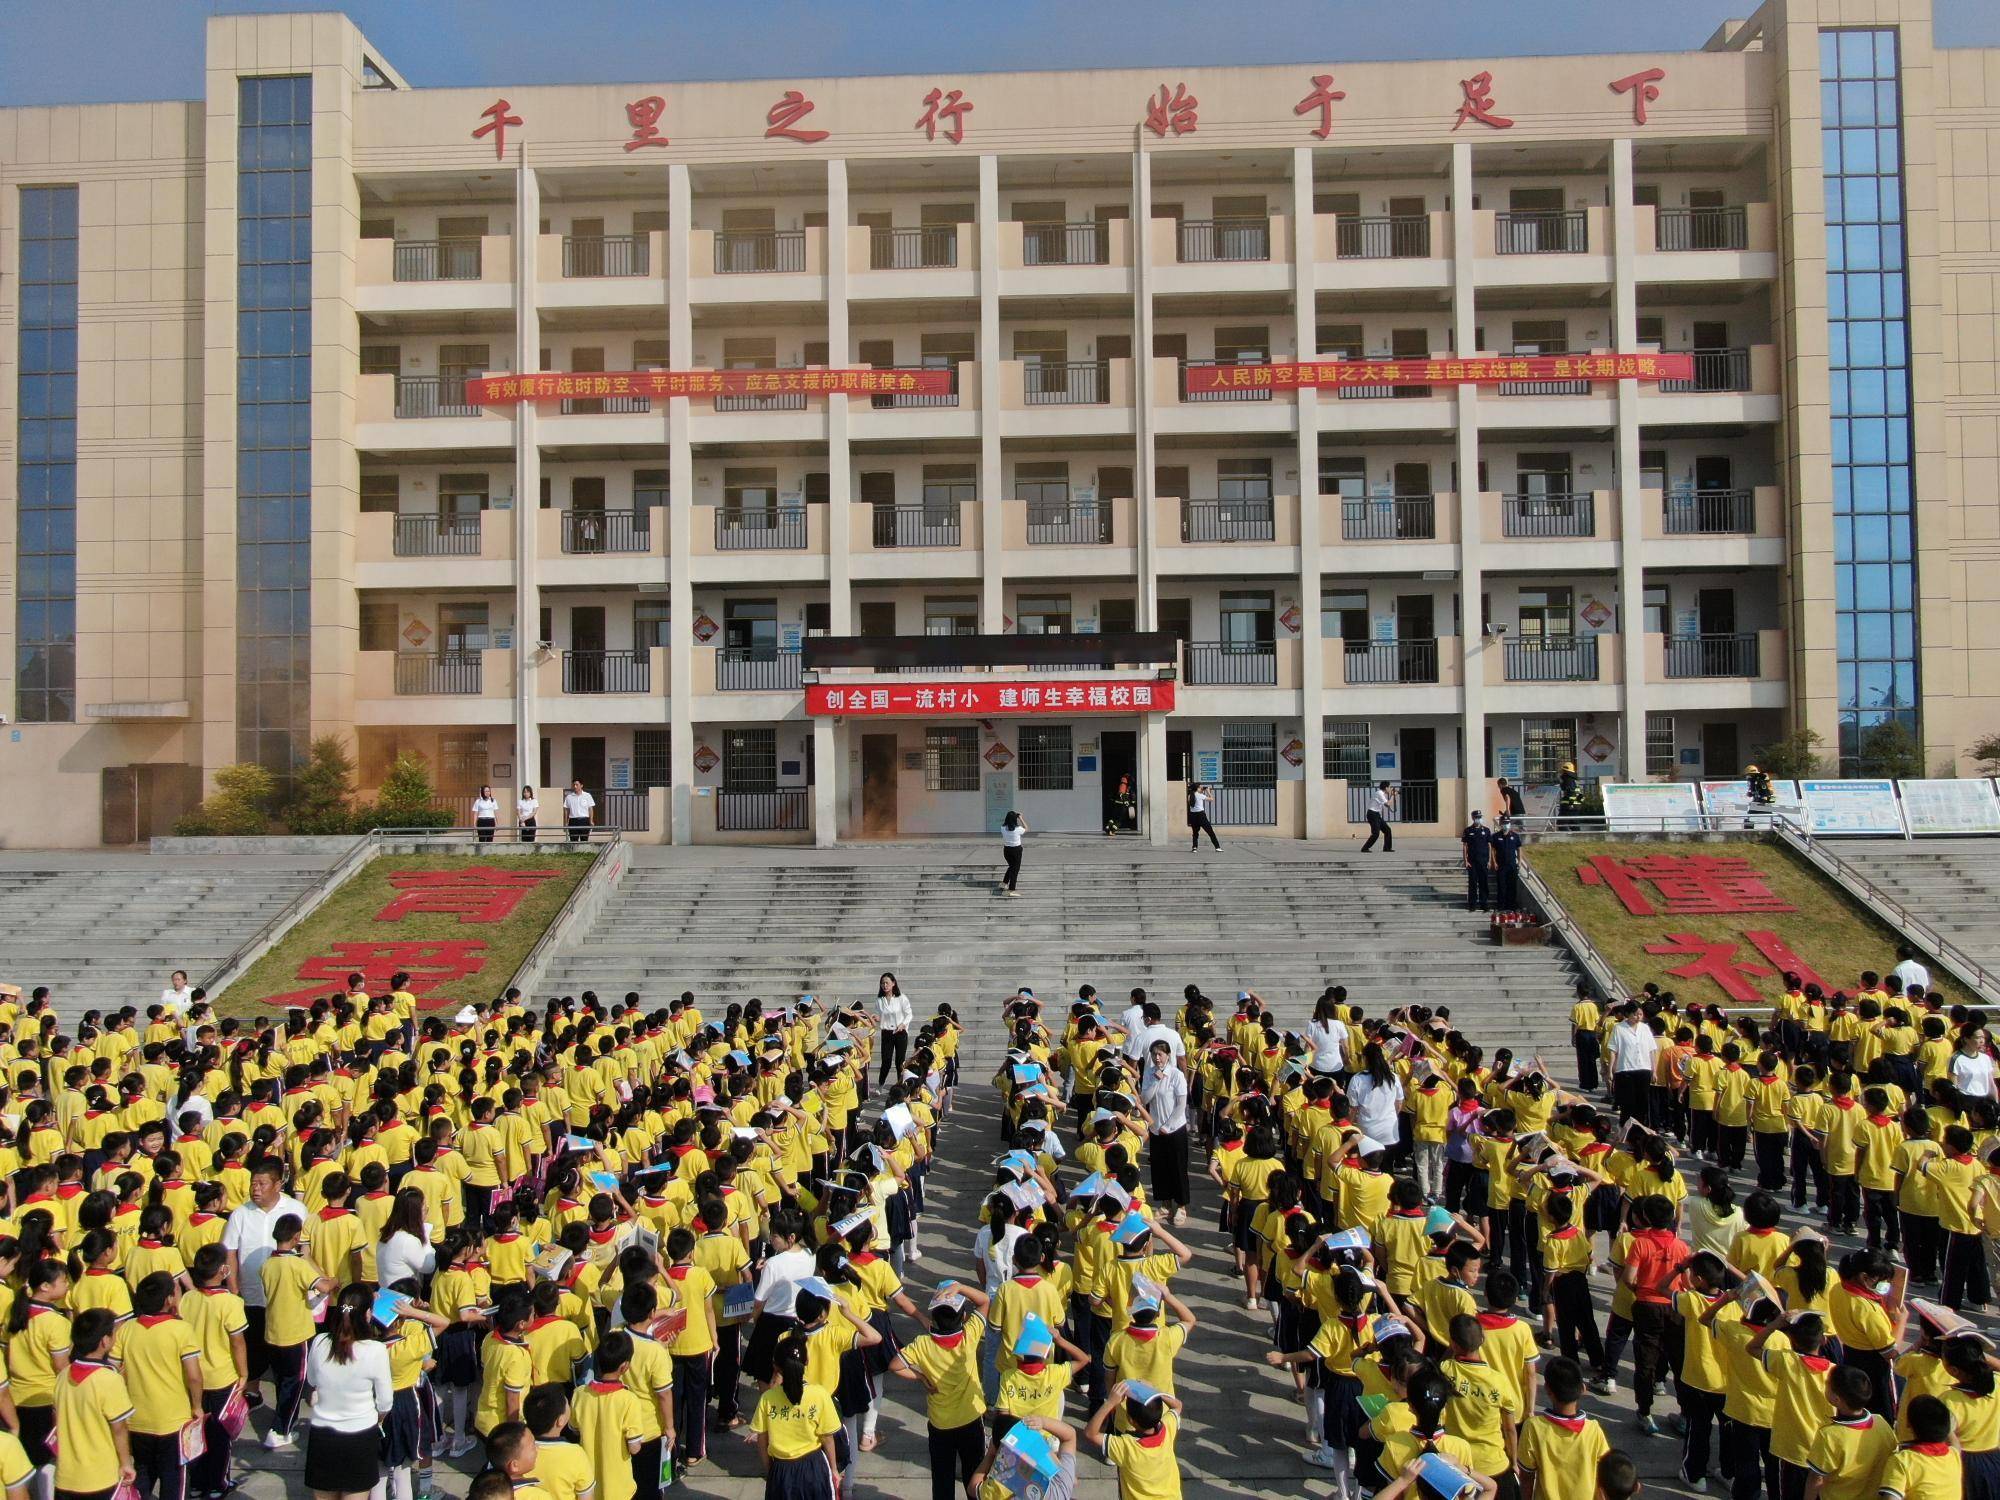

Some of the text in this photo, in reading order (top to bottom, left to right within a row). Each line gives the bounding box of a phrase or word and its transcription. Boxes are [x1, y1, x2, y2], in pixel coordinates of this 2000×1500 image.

[471, 67, 1666, 161] 千里之行 始于足下
[825, 686, 1153, 710] 创全国一流村小 建师生幸福校园
[1575, 854, 1882, 1002] 懂礼
[768, 1404, 817, 1421] 马岗小学
